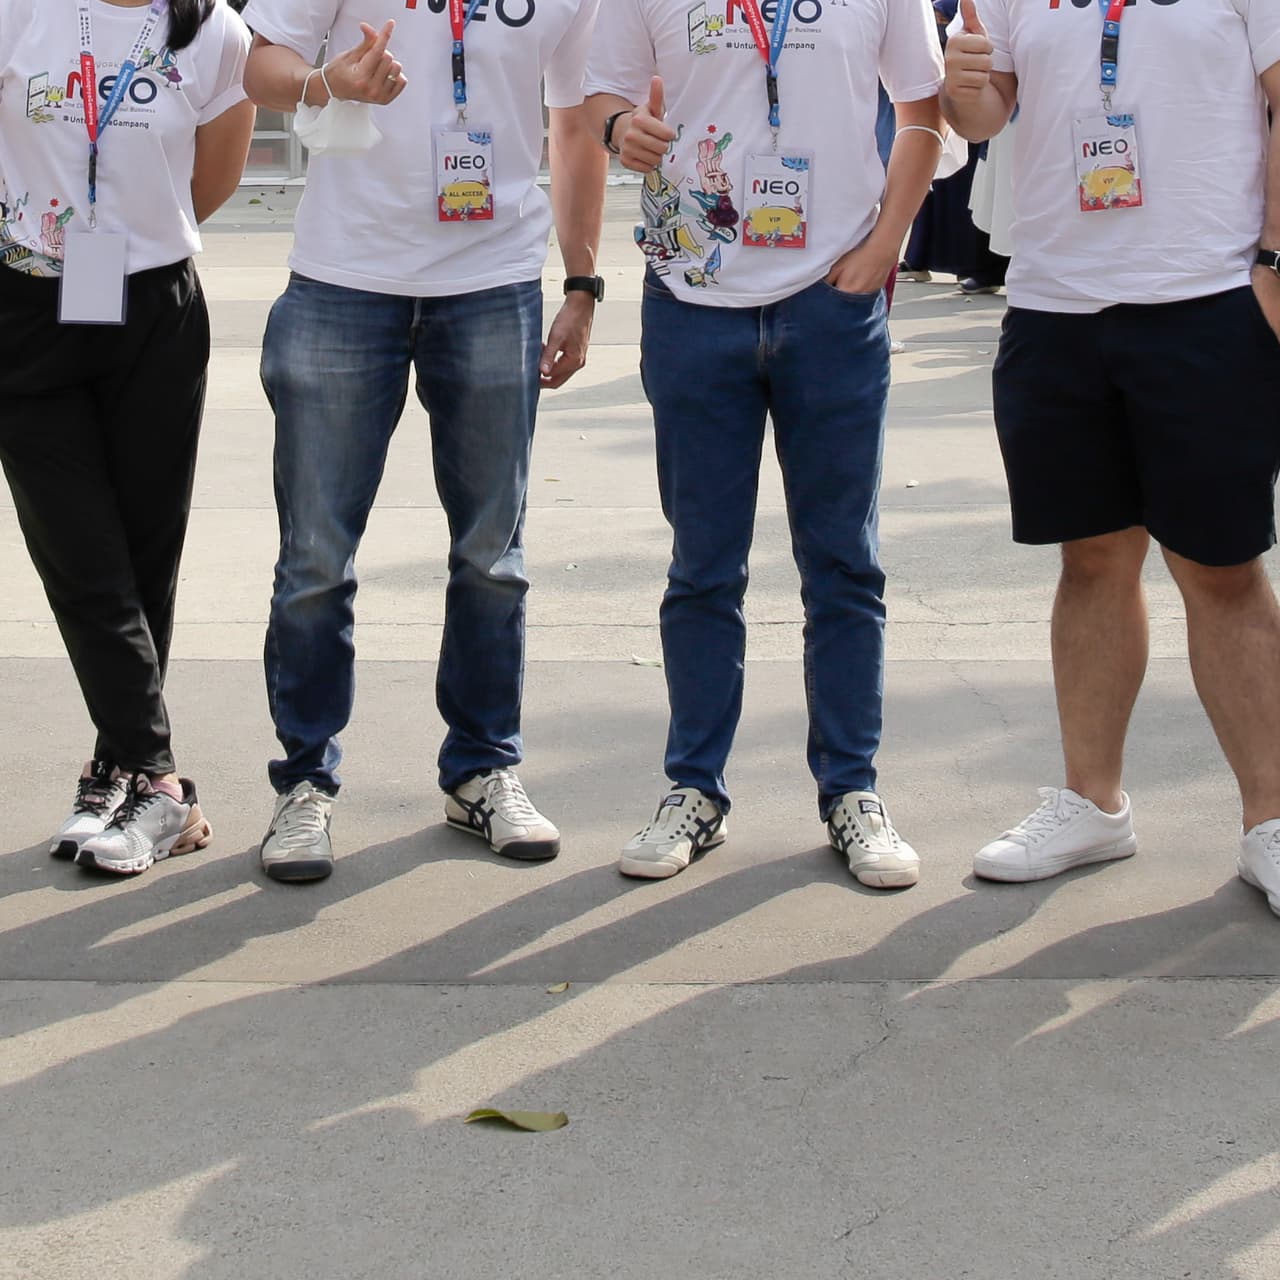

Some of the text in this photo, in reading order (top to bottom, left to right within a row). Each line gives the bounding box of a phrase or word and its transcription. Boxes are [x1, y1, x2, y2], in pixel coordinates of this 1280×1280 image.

[726, 42, 815, 50] #Untunampang
[63, 115, 149, 129] #UntaGampang
[1082, 139, 1128, 158] NEO
[444, 154, 485, 170] NEO
[753, 180, 799, 195] NEO
